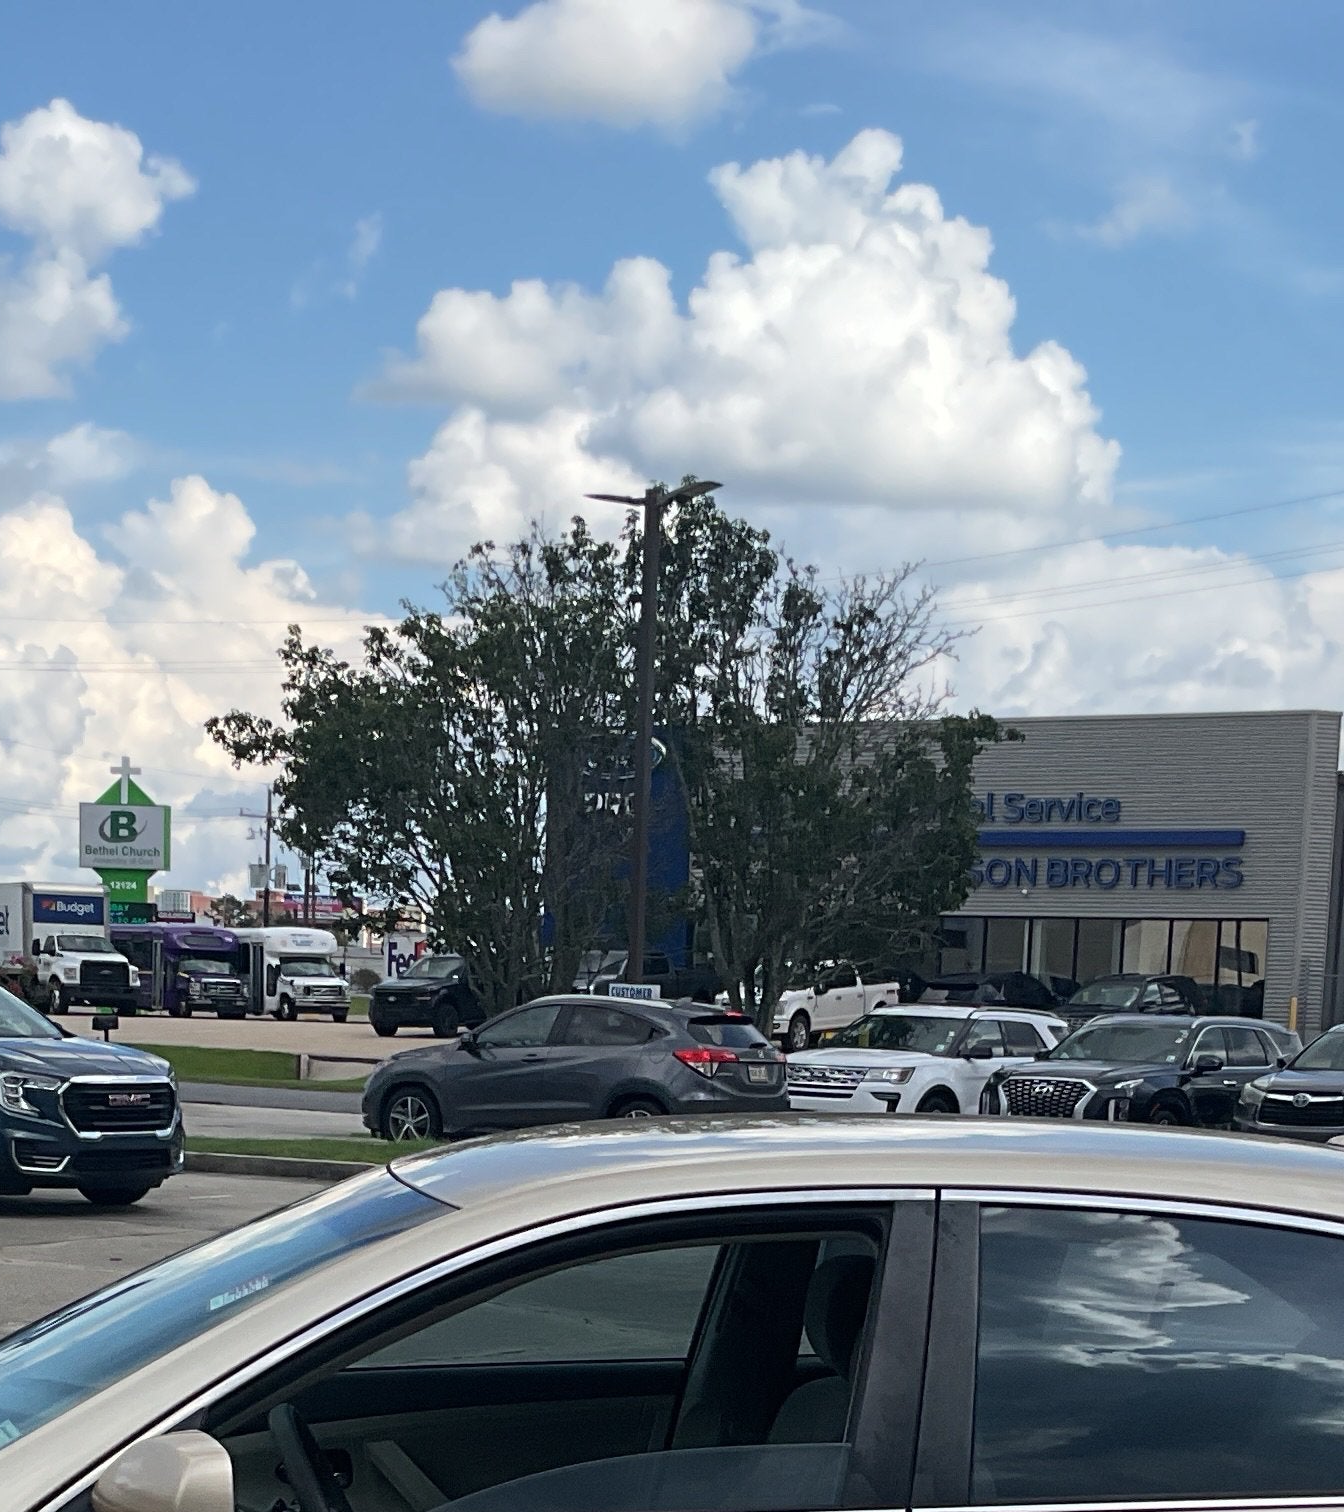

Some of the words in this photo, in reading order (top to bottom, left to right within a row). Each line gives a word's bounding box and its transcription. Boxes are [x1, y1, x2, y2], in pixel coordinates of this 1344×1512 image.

[1004, 792, 1121, 822] Service
[85, 845, 119, 856] Bethel
[121, 846, 161, 857] Church
[1046, 857, 1244, 890] BROTHERS
[110, 881, 137, 890] 12124
[56, 901, 94, 916] Budget
